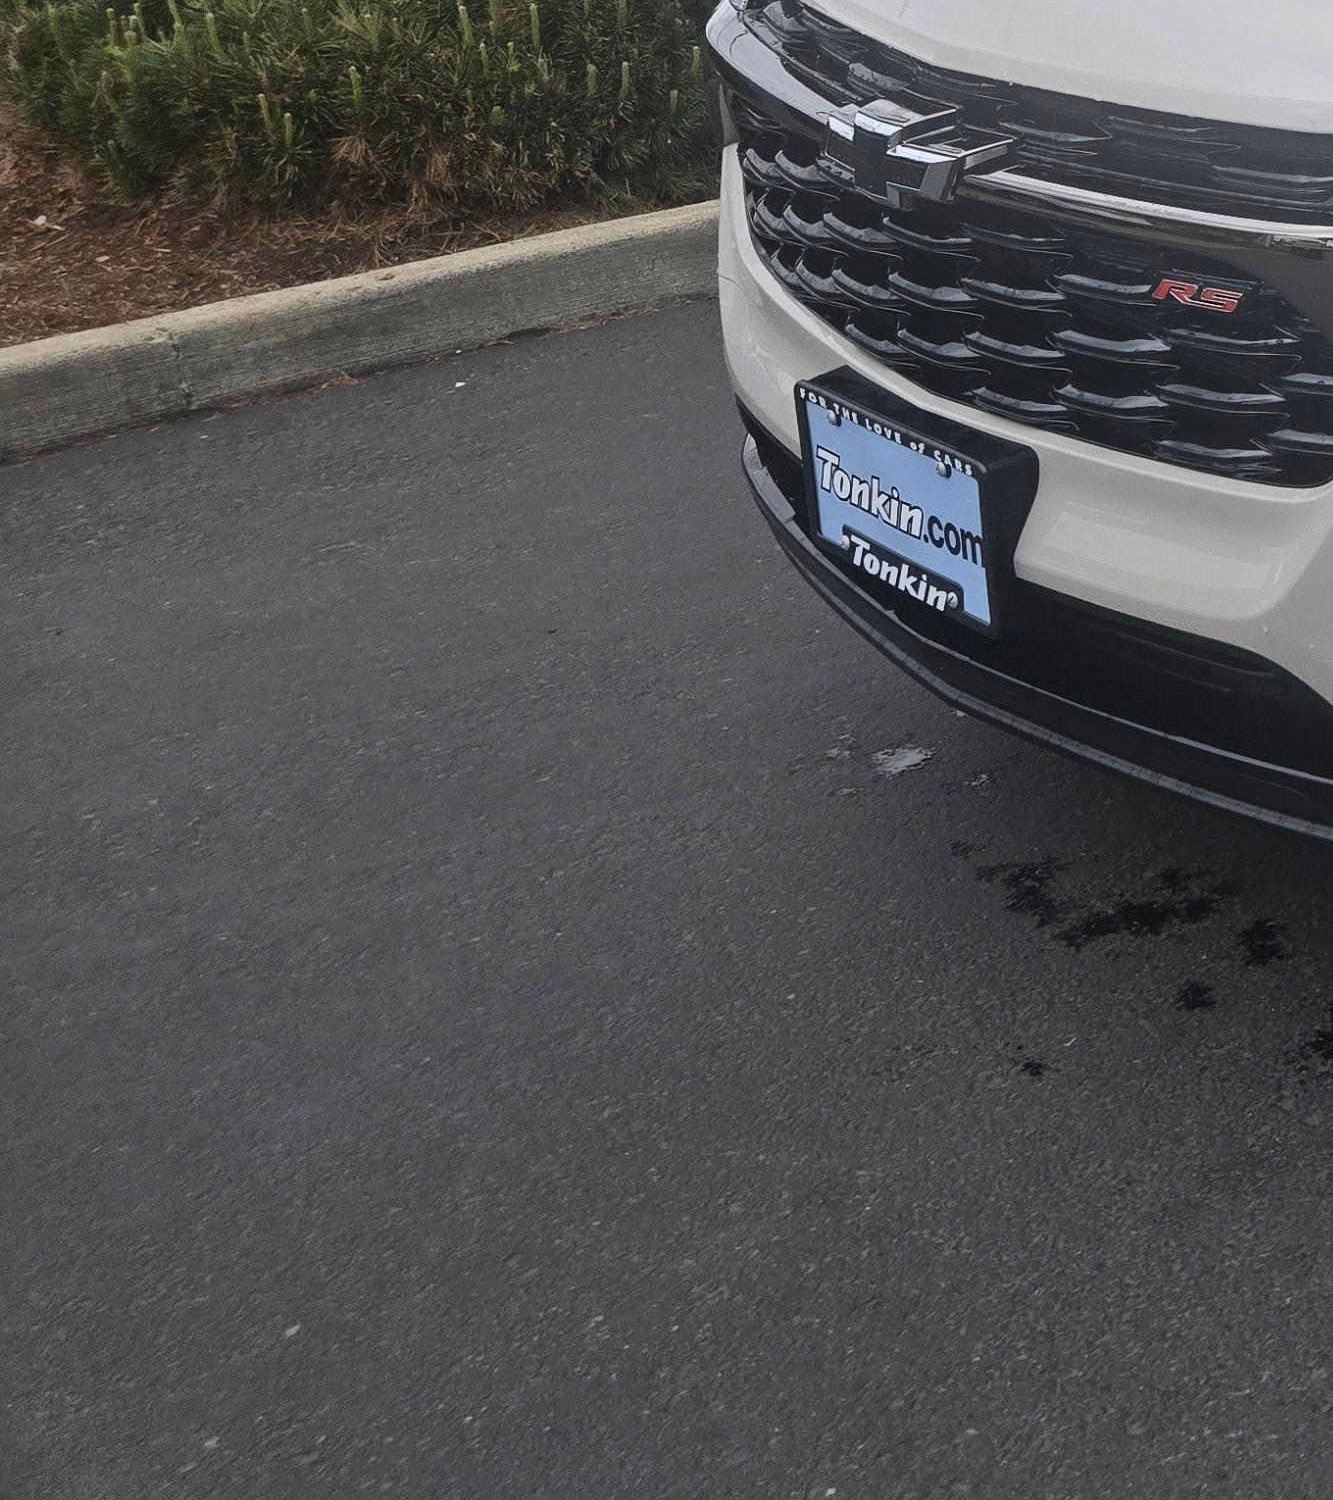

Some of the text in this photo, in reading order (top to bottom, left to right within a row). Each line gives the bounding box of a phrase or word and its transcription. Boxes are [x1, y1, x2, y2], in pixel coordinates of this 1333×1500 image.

[1152, 279, 1243, 313] RS
[799, 387, 828, 409] FOR
[833, 403, 859, 425] THE
[865, 418, 902, 445] LOVE
[933, 449, 973, 477] CARS
[815, 444, 986, 569] Tonkin.com
[849, 534, 948, 613] Tonkin
